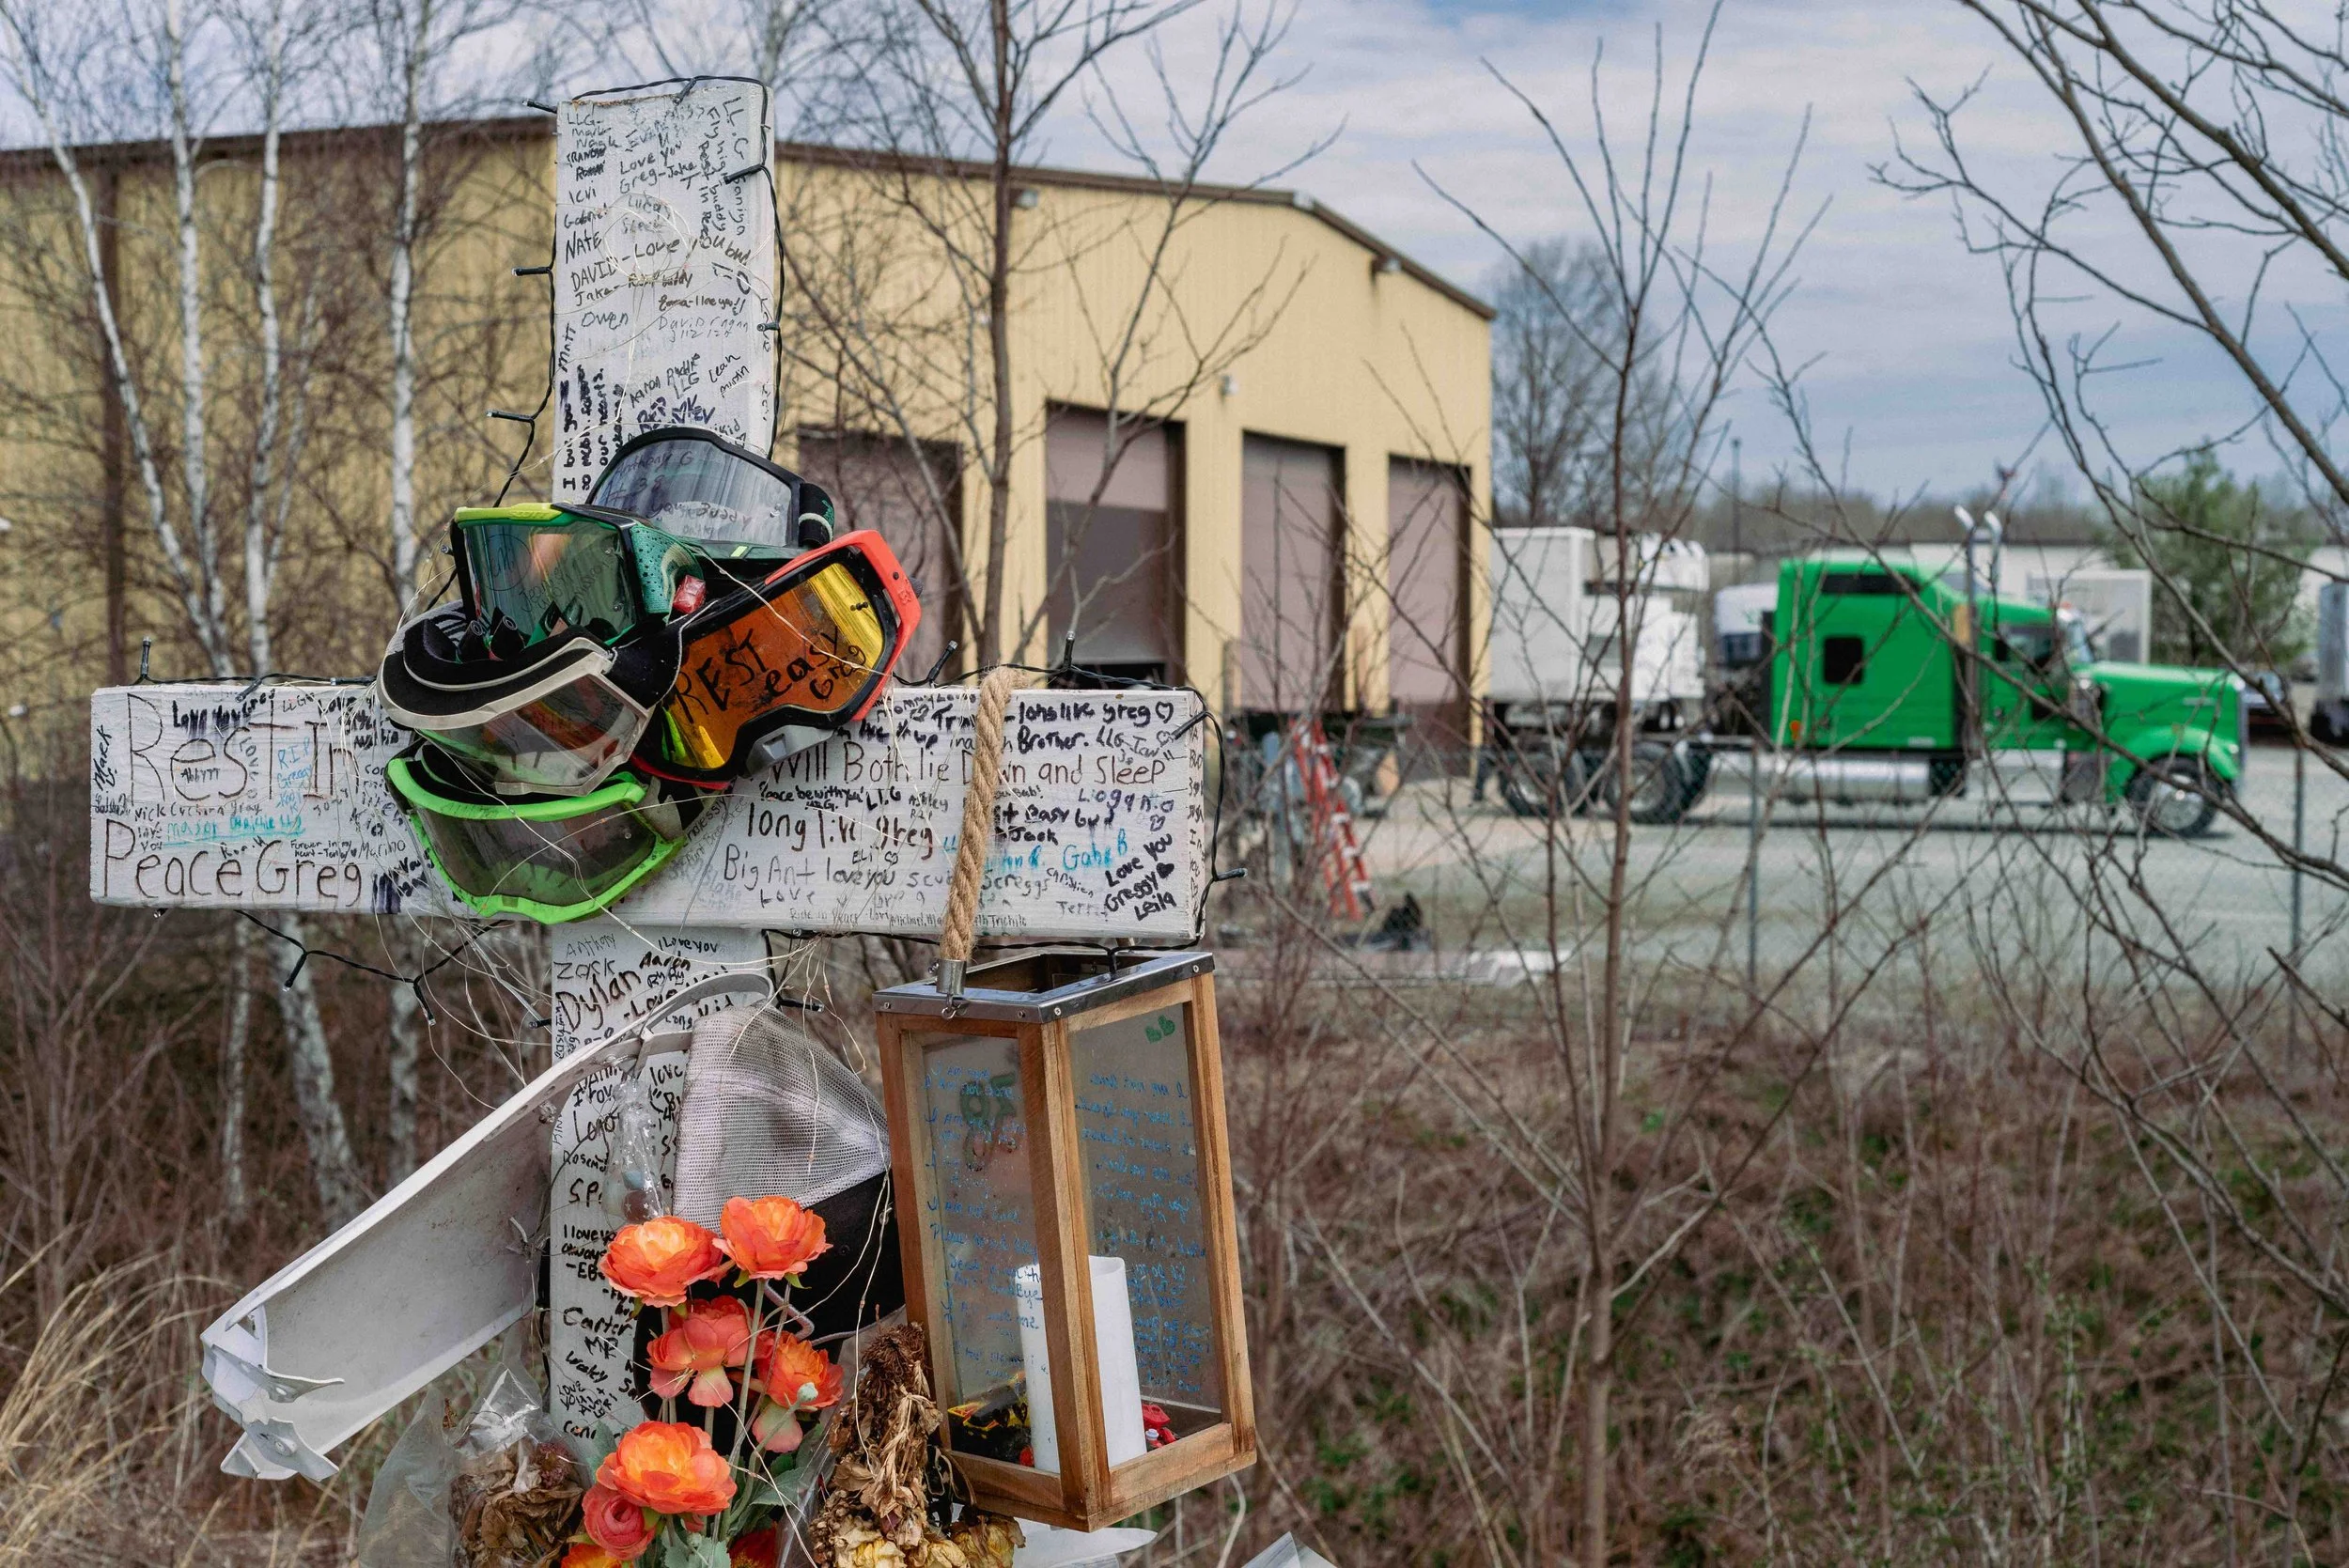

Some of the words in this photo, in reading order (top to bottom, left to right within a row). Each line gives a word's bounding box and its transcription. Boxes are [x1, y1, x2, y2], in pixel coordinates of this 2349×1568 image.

[571, 256, 618, 292] DAVID
[674, 629, 767, 723] REST
[844, 742, 910, 782] Both
[920, 747, 949, 782] lie
[962, 750, 1025, 784] Dwn
[1039, 754, 1082, 784] and
[748, 802, 806, 852] long
[257, 839, 363, 908] Greg
[724, 844, 759, 891] Big
[769, 856, 817, 885] Ant
[555, 970, 642, 1032] Dylan
[571, 1224, 599, 1241] love
[564, 1307, 632, 1336] Carter
